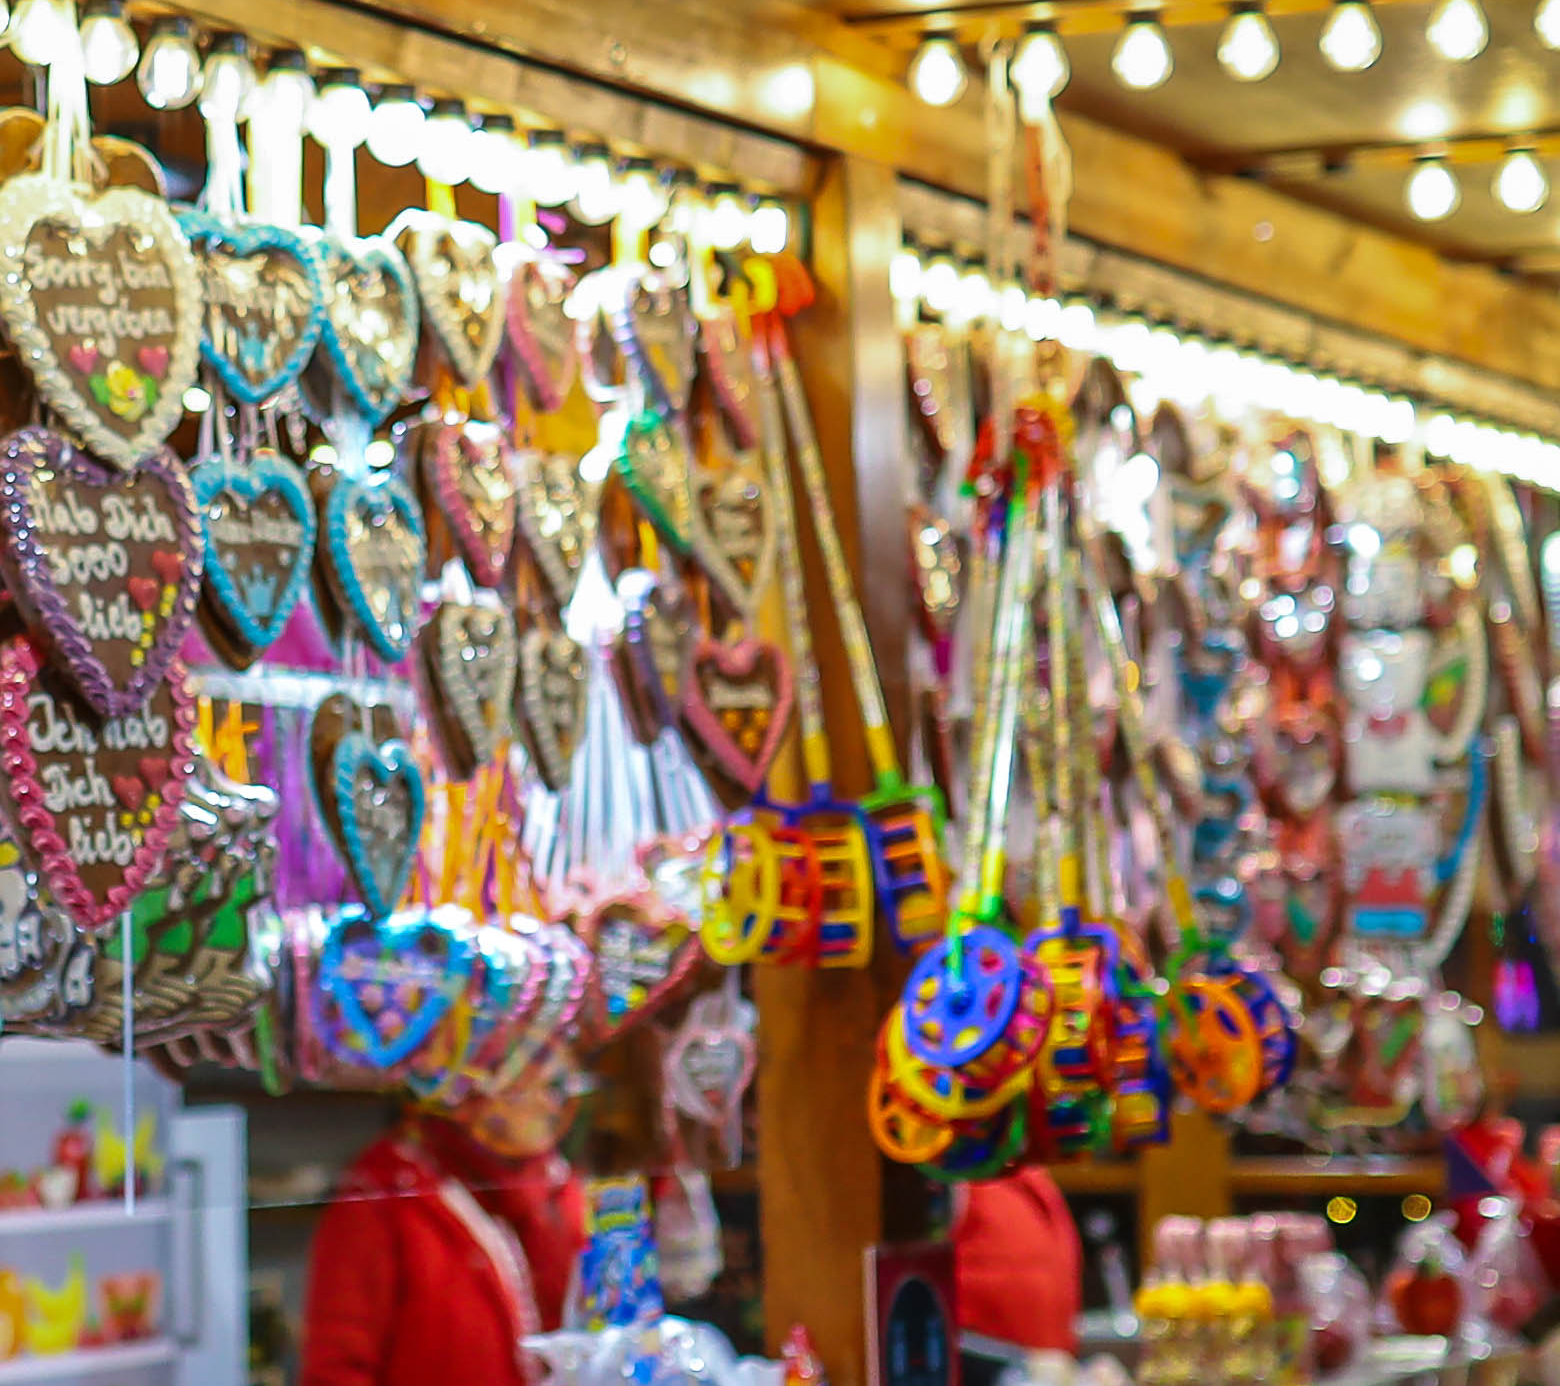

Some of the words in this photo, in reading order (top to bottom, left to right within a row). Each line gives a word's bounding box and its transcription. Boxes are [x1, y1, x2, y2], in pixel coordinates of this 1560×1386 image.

[25, 243, 122, 305] Sorry,
[100, 480, 177, 541] Dich
[79, 591, 142, 642] lieb
[27, 691, 99, 754] Ich
[42, 755, 114, 813] Dich
[68, 812, 132, 866] lieb
